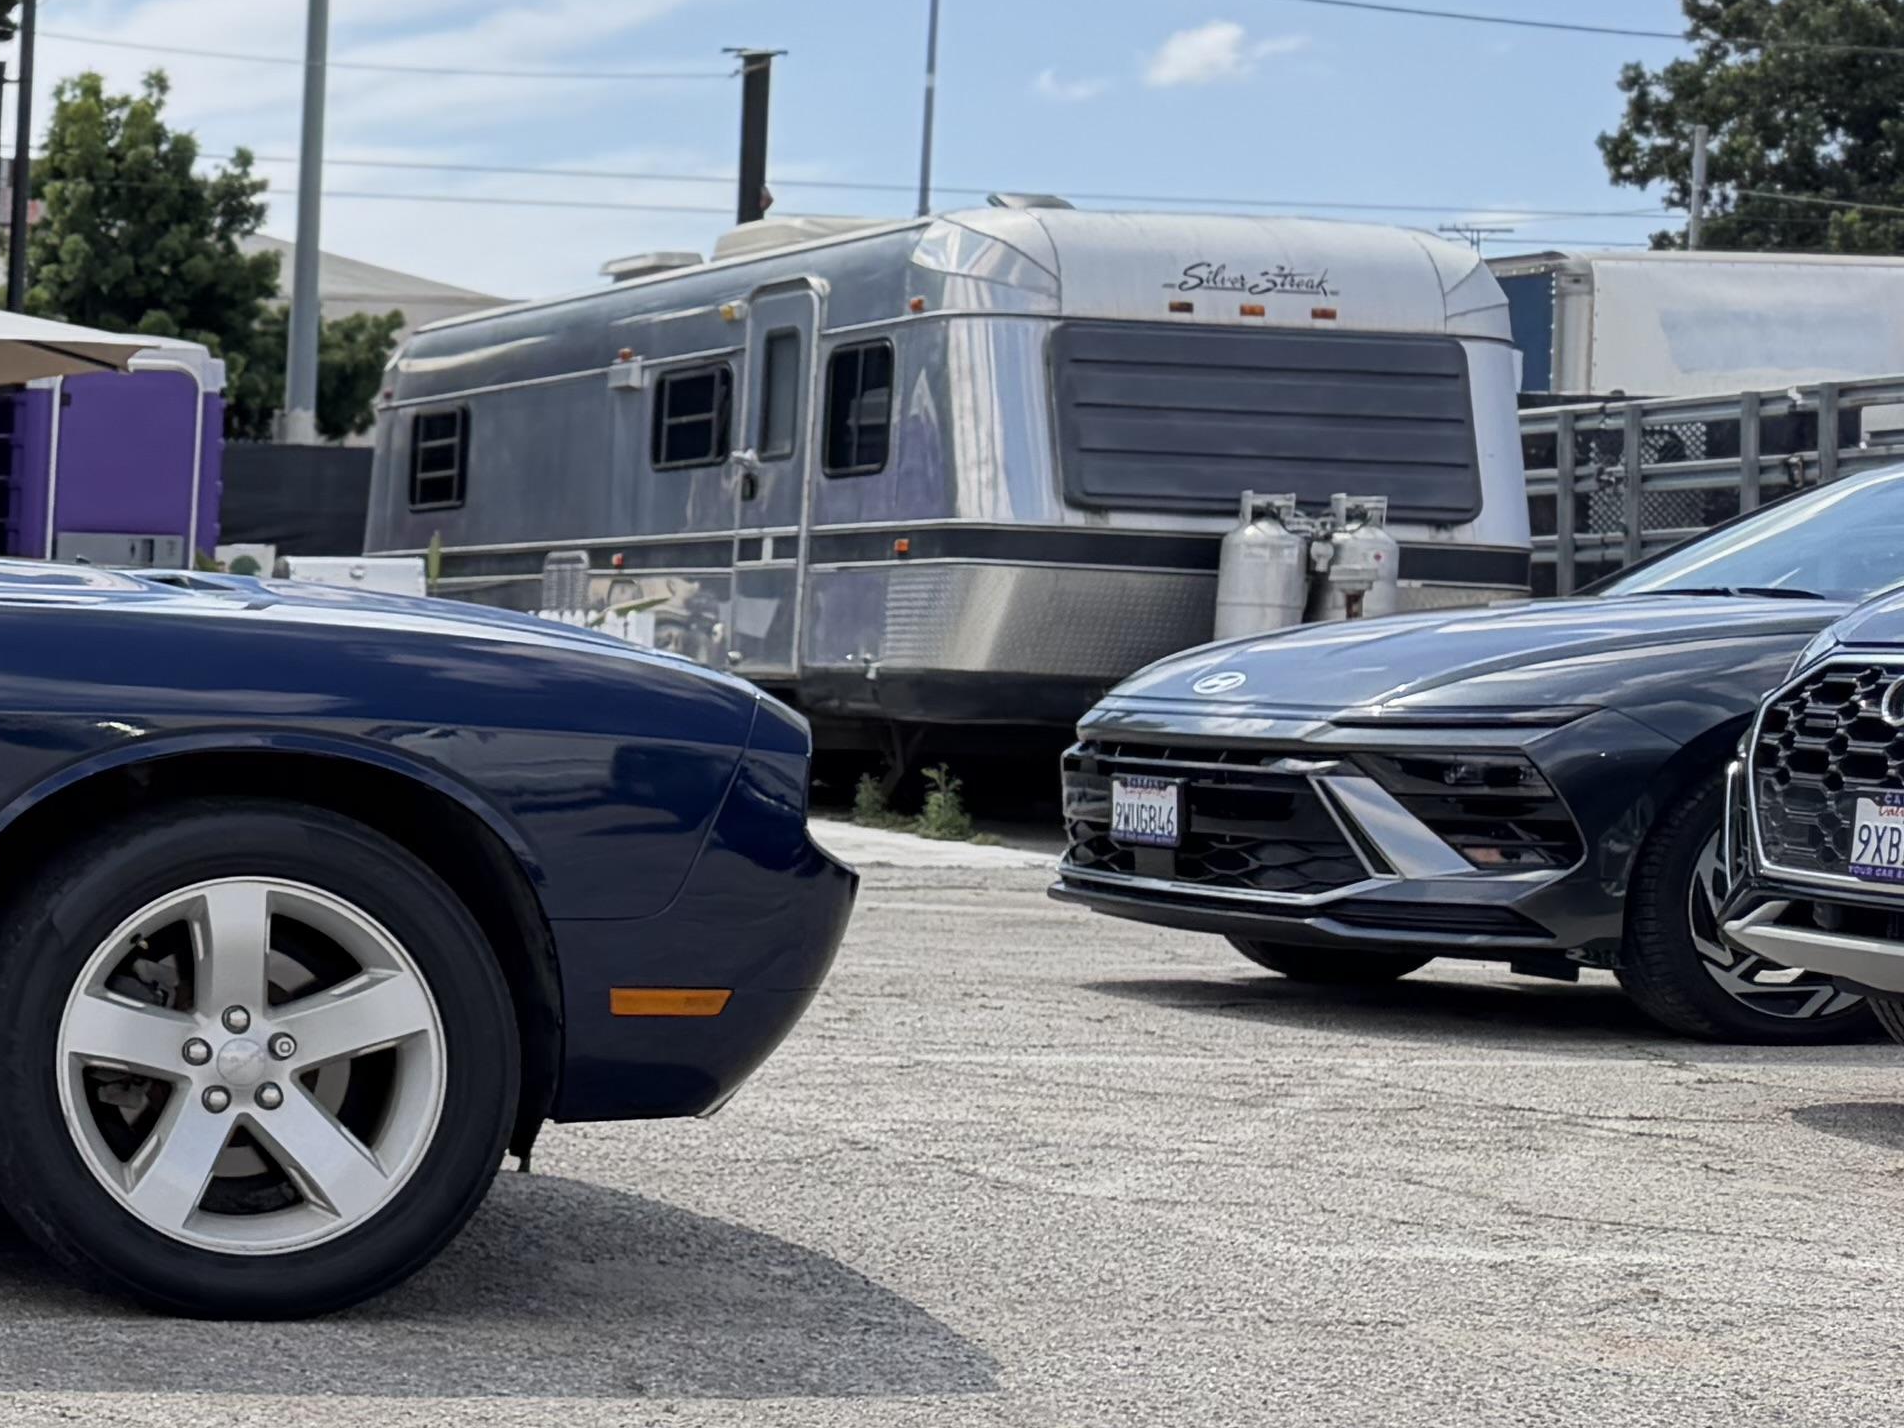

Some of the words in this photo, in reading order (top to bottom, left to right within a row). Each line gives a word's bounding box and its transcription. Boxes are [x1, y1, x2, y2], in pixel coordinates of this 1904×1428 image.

[1178, 261, 1247, 291] Silver
[1248, 264, 1329, 296] Streak
[1884, 793, 1904, 805] CA
[1115, 801, 1174, 836] 9WUG846
[1855, 823, 1904, 865] 9XB
